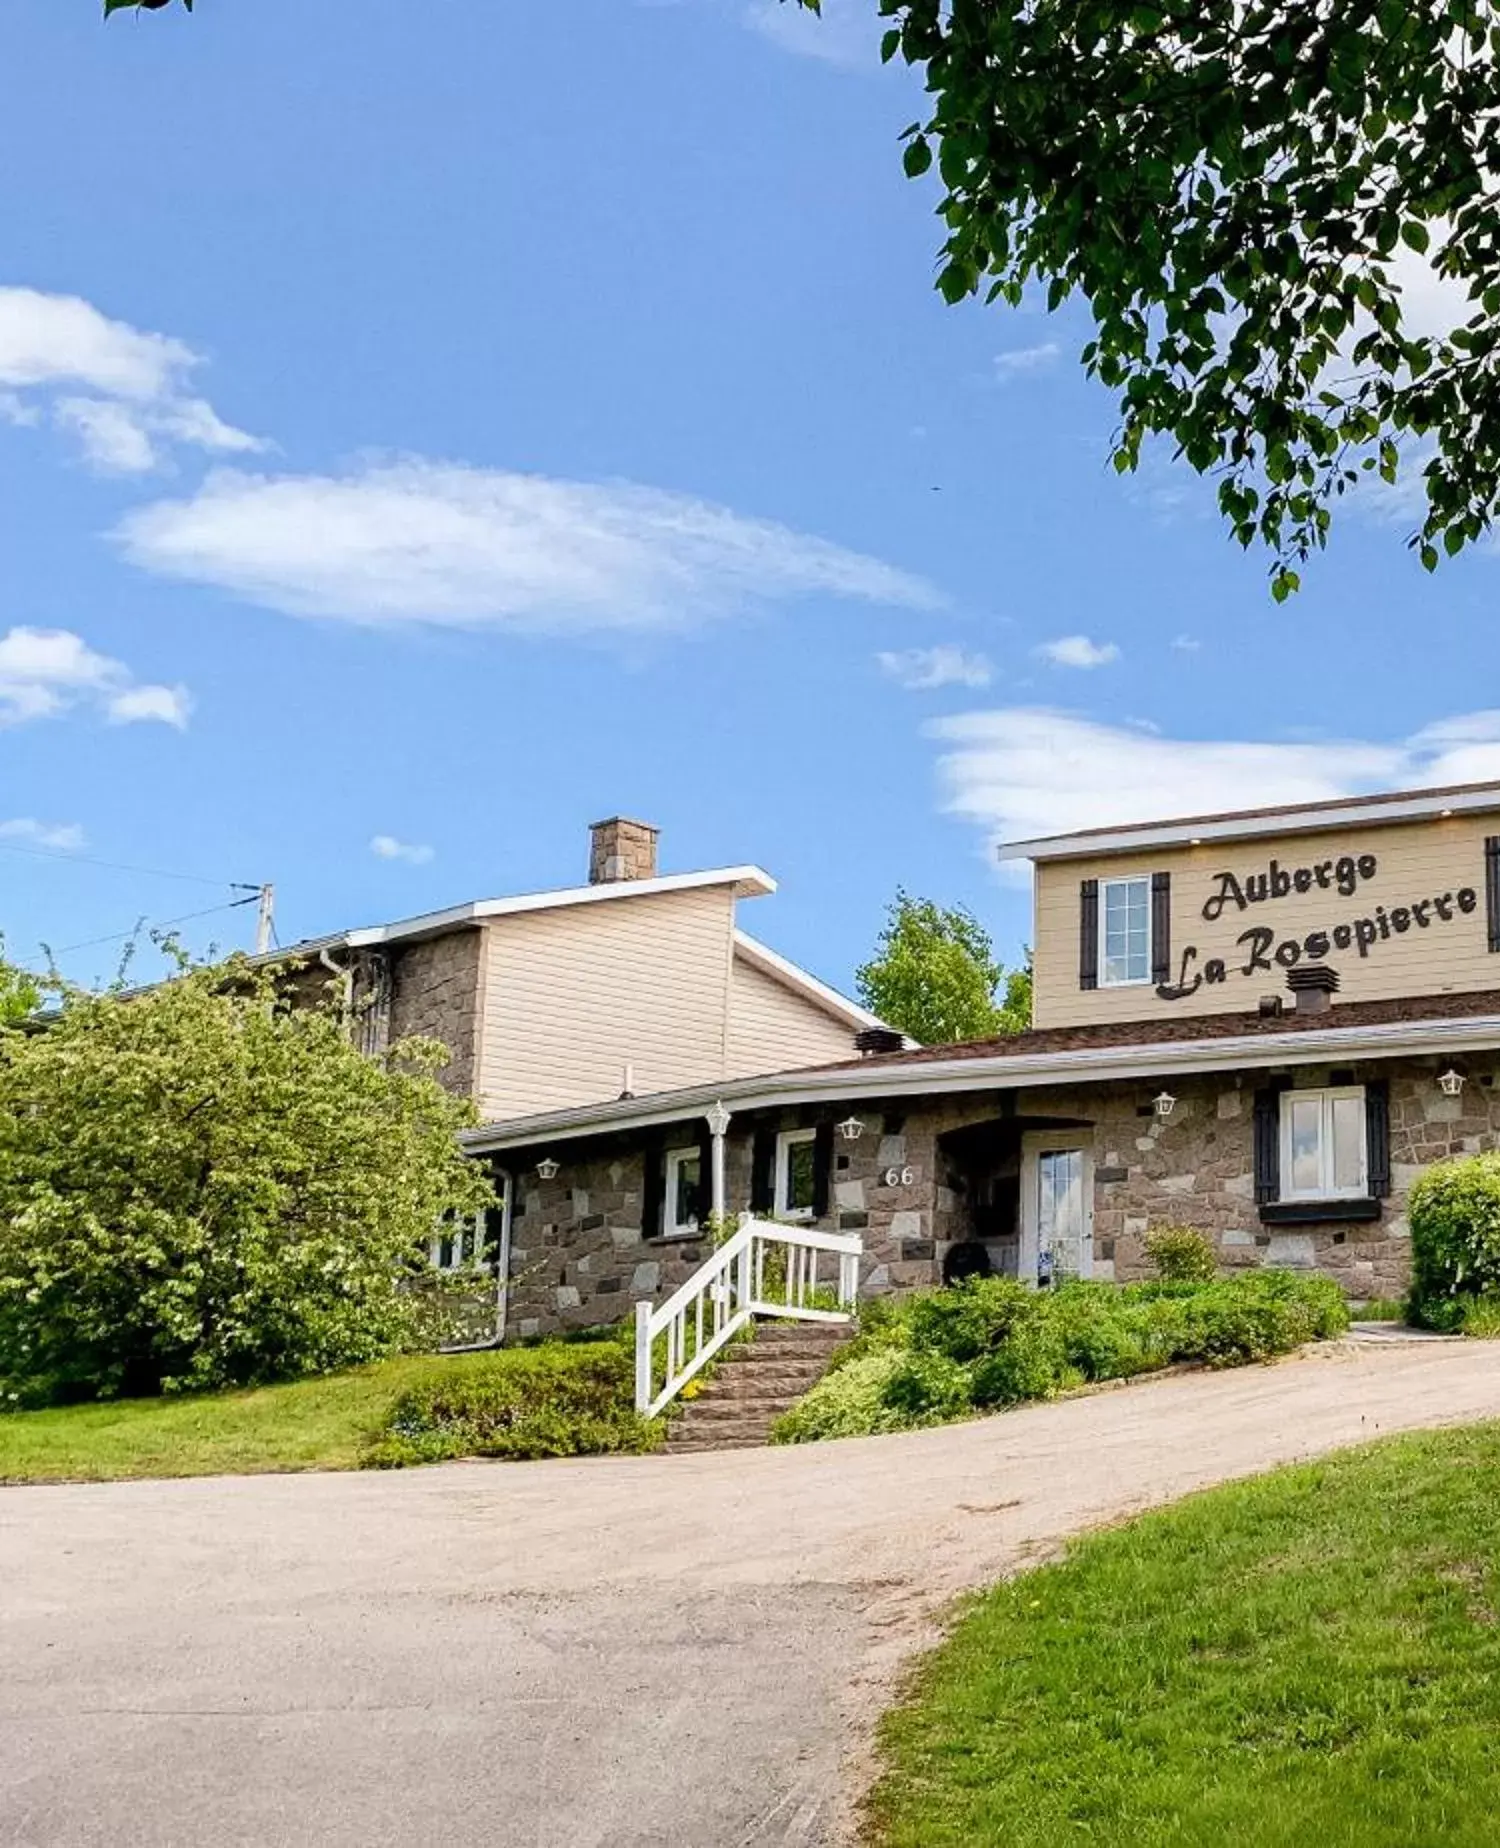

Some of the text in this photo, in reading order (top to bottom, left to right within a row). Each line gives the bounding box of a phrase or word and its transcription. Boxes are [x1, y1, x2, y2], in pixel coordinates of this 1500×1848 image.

[1202, 854, 1377, 921] Auberge
[1155, 887, 1477, 1000] La Rosepierre
[885, 1165, 914, 1187] 66
